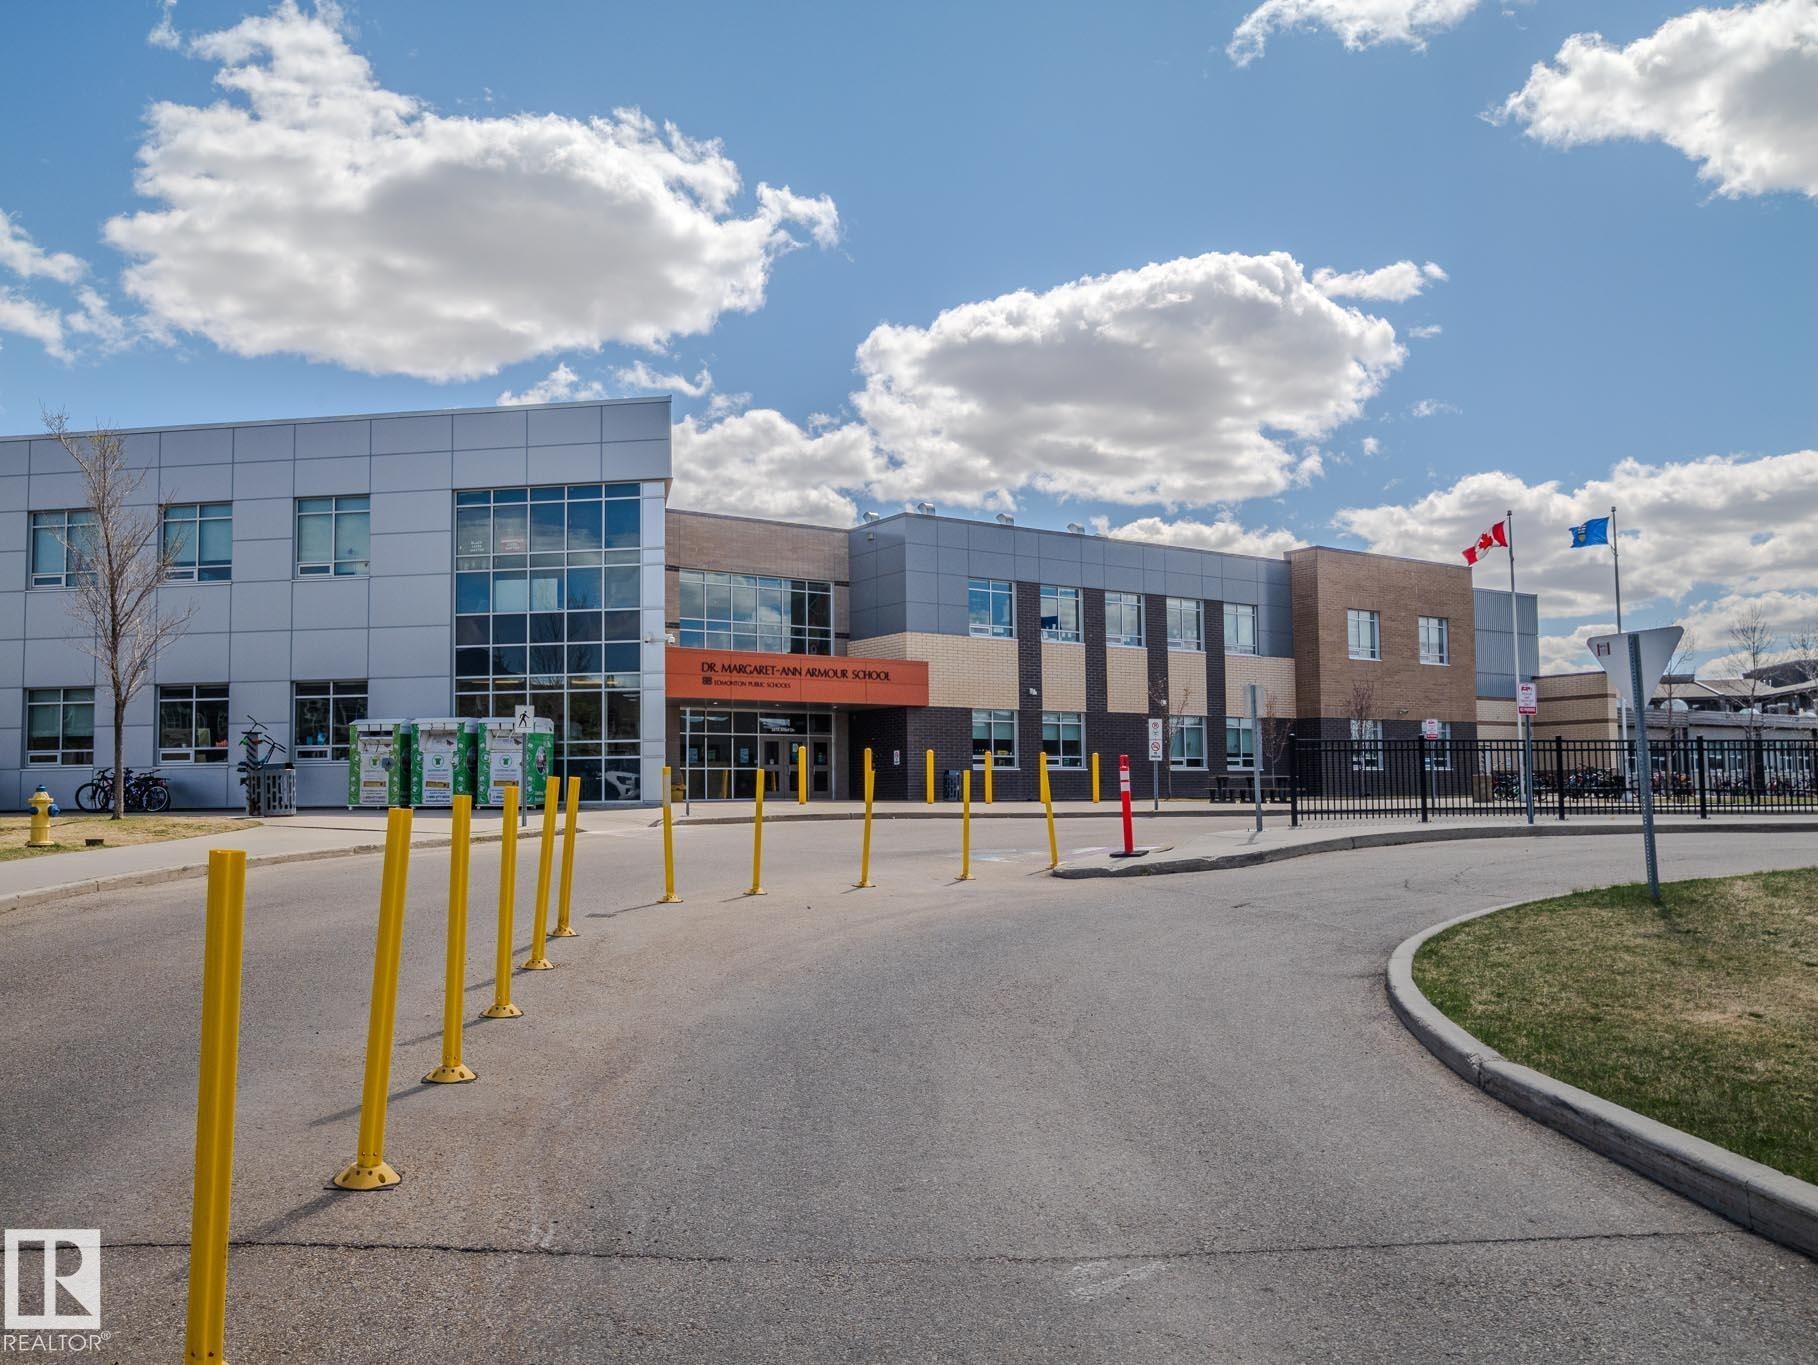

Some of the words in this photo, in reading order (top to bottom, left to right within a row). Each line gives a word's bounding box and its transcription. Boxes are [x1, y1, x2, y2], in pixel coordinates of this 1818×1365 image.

[701, 662, 719, 673] DR.
[721, 664, 802, 676] MARGARET-ANN
[805, 668, 848, 679] ARMOUR
[852, 670, 890, 681] SCHOOL
